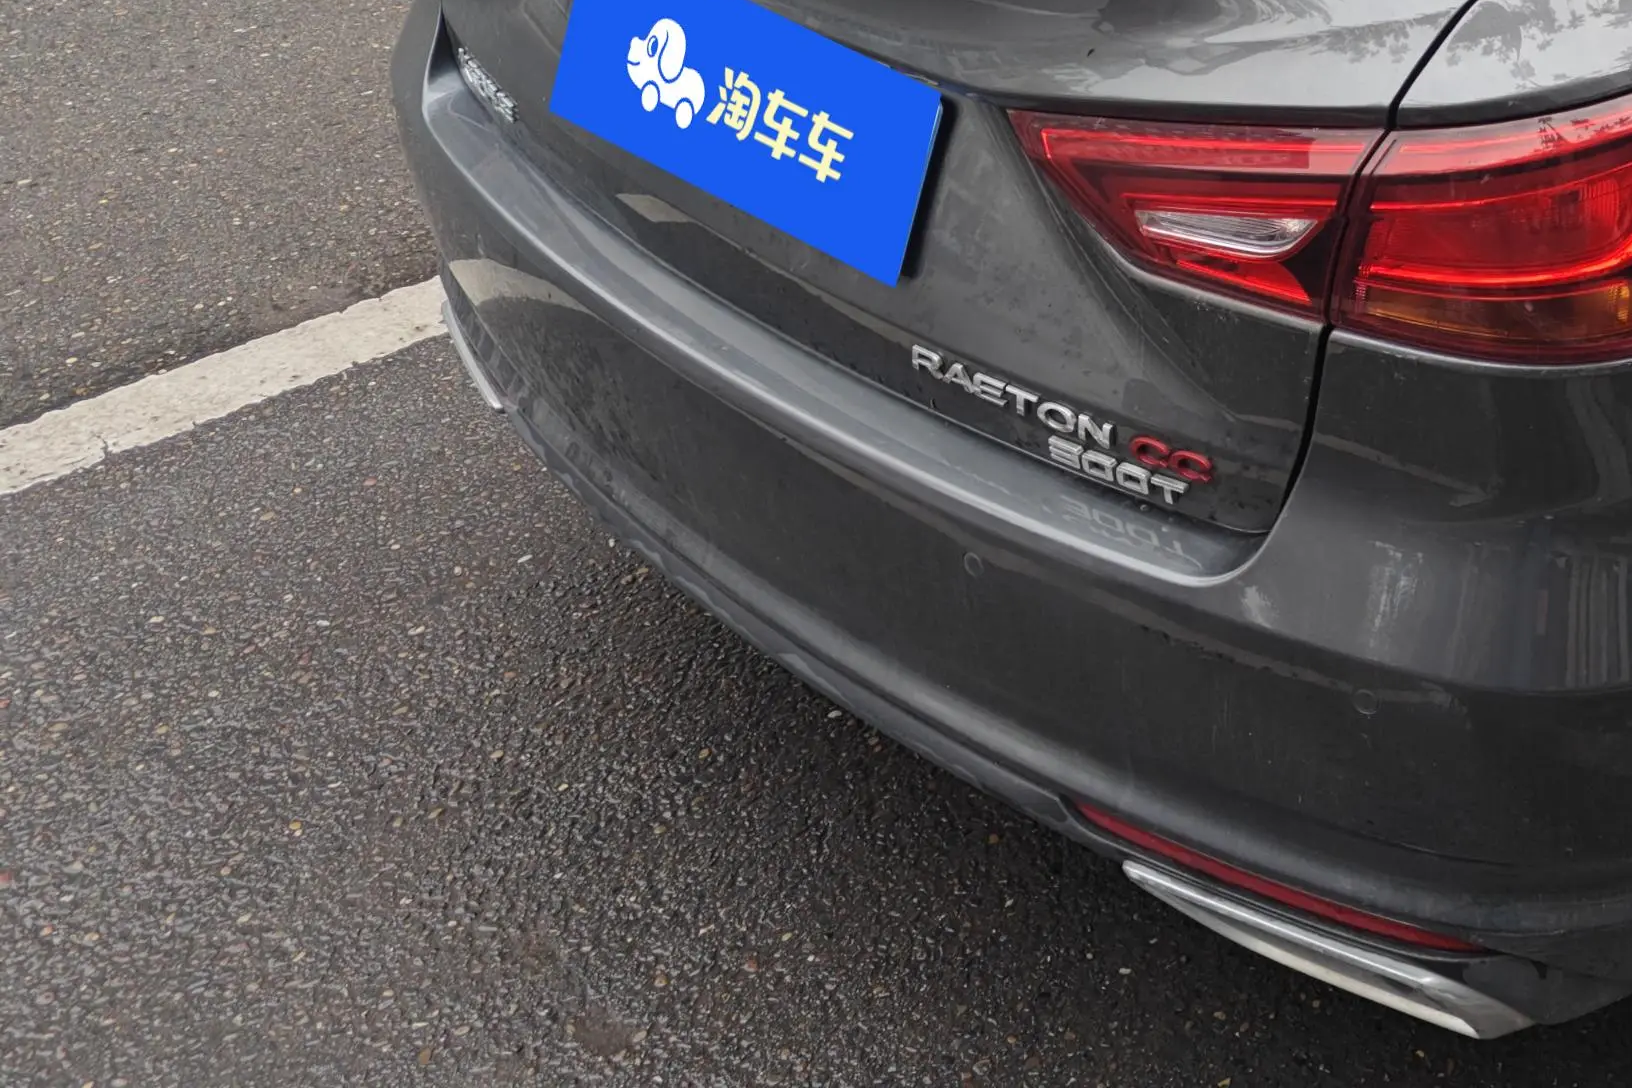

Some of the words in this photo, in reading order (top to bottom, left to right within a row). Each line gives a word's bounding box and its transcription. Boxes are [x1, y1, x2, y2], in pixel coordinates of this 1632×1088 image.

[911, 343, 1117, 450] RAETON
[1128, 434, 1214, 483] CC
[1048, 434, 1190, 505] 300T
